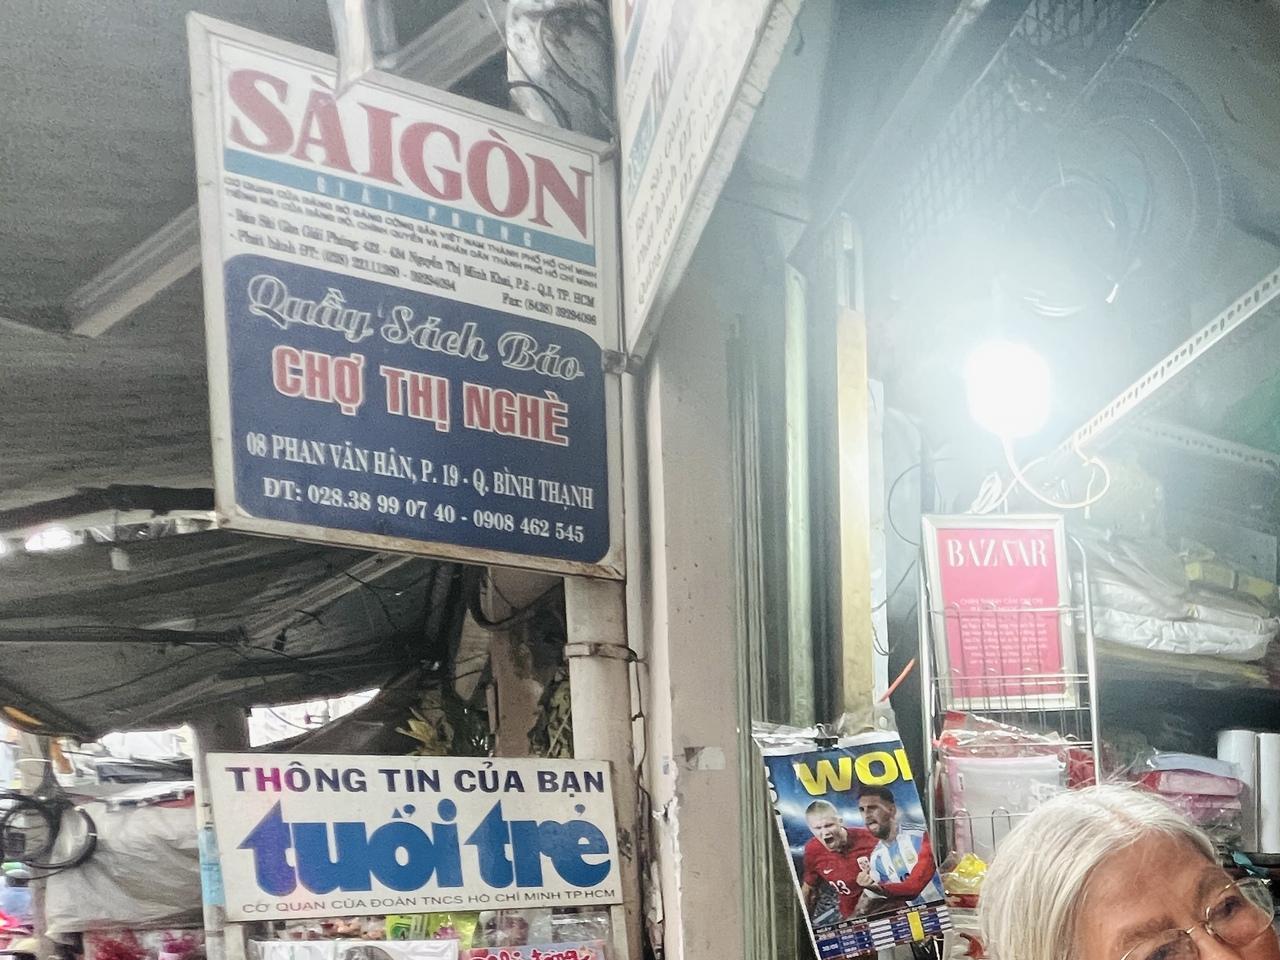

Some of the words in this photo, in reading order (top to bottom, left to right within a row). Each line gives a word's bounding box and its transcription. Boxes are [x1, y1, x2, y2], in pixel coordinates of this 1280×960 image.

[229, 69, 591, 239] SÀIGÒN
[247, 274, 374, 341] Quầy
[381, 302, 488, 362] Sách
[500, 331, 584, 382] Báo
[271, 344, 365, 416] CHỢ
[380, 363, 450, 433] THỊ
[463, 380, 569, 447] NGHÈ
[246, 433, 268, 457] 08
[271, 435, 326, 466] PHAN
[330, 439, 369, 471] VĂN
[421, 459, 437, 483] P.
[442, 463, 459, 487] 19
[472, 469, 489, 495] Q.
[493, 464, 535, 501] BÌNH
[539, 478, 594, 511] THẠNH
[263, 477, 302, 503] ĐT:
[307, 485, 371, 513] 028.38
[377, 492, 400, 517] 99
[405, 497, 428, 521] 07
[433, 500, 456, 525] 40
[473, 506, 515, 535] 0908
[520, 512, 550, 539] 462
[555, 517, 584, 544] 545
[947, 539, 1048, 567] BAZAAR
[225, 761, 368, 793] THÔNG
[378, 769, 440, 793] TIN
[454, 761, 526, 793] CỦA
[537, 770, 604, 798] BẠN
[236, 799, 463, 897] tuổi
[464, 800, 611, 890] trẻ
[275, 900, 325, 913] QUAN
[331, 895, 367, 910] CỦA
[421, 894, 463, 905] TNCS
[525, 889, 561, 902] MINH
